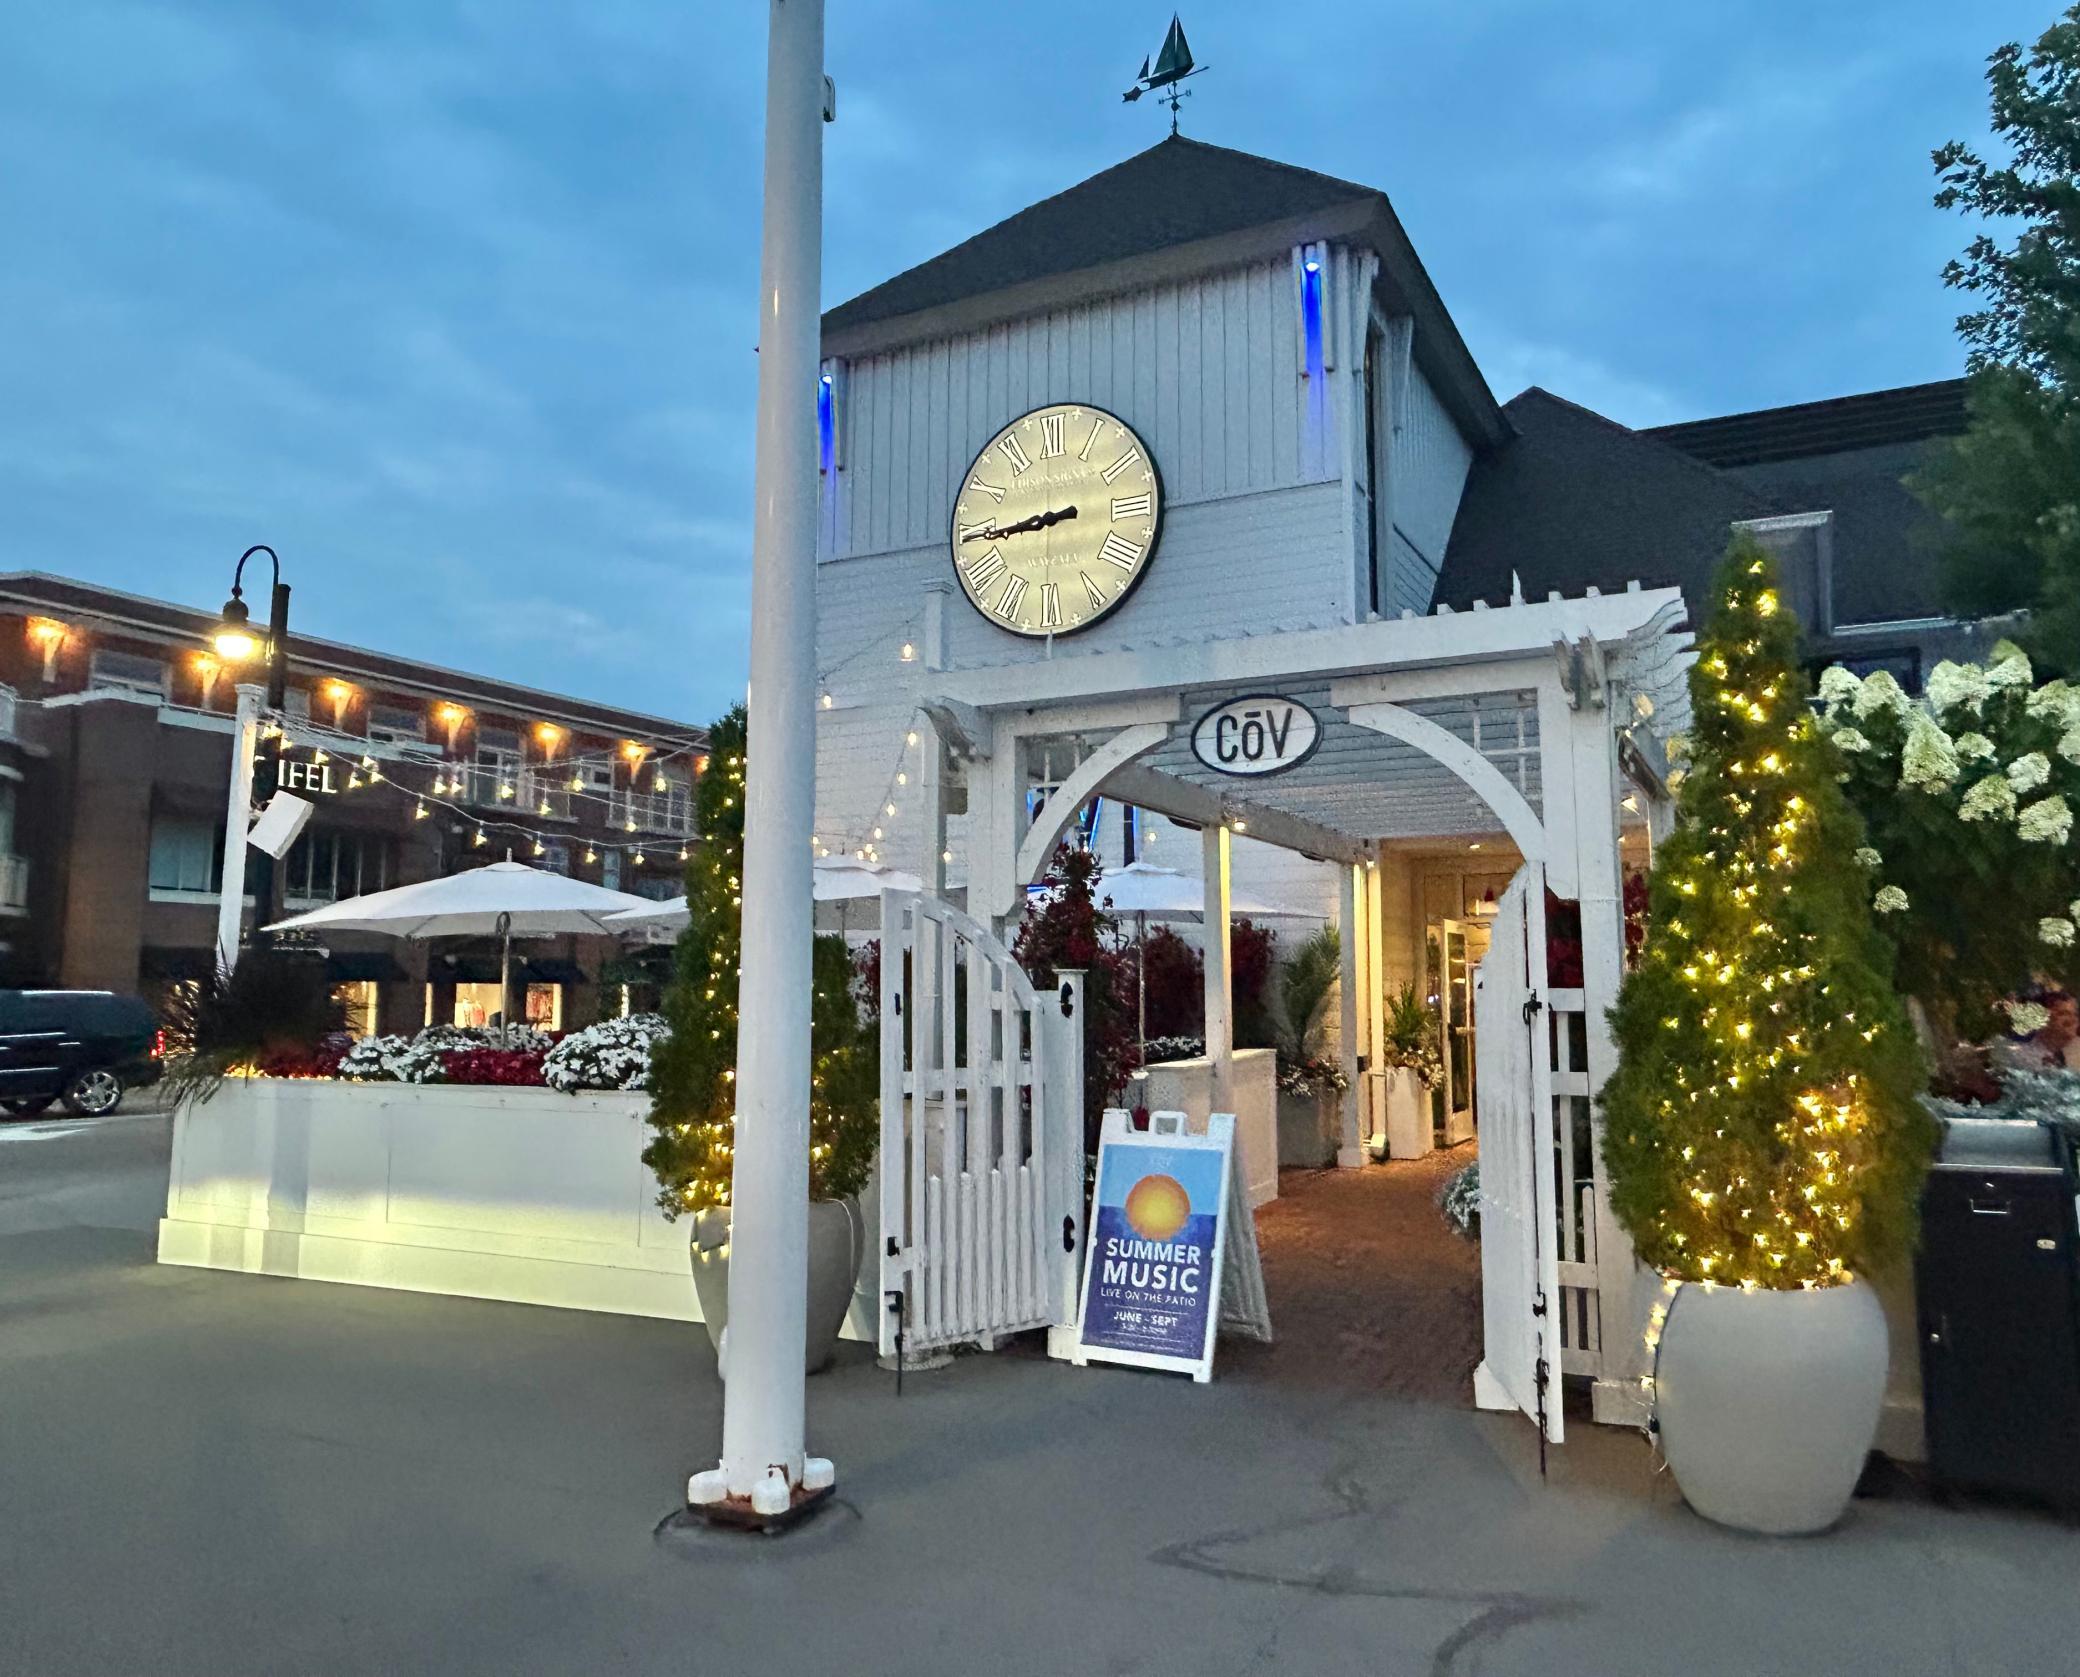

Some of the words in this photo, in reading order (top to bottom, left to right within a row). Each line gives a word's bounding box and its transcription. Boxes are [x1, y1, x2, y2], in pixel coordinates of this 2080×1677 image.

[1040, 413, 1066, 460] XII
[1078, 417, 1105, 462] I
[997, 431, 1033, 478] XI
[1100, 445, 1141, 486] II
[969, 475, 1006, 504] X
[1111, 491, 1151, 522] III
[1106, 1237, 1200, 1265] SUMMER
[1102, 1259, 1200, 1293] MUSIC
[1100, 1286, 1121, 1298] LIVE
[1124, 1290, 1140, 1301] ON
[1143, 1292, 1162, 1303] THE
[1164, 1295, 1196, 1307] PATIO
[1113, 1311, 1142, 1323] JUNE
[1150, 1314, 1179, 1327] SEPT
